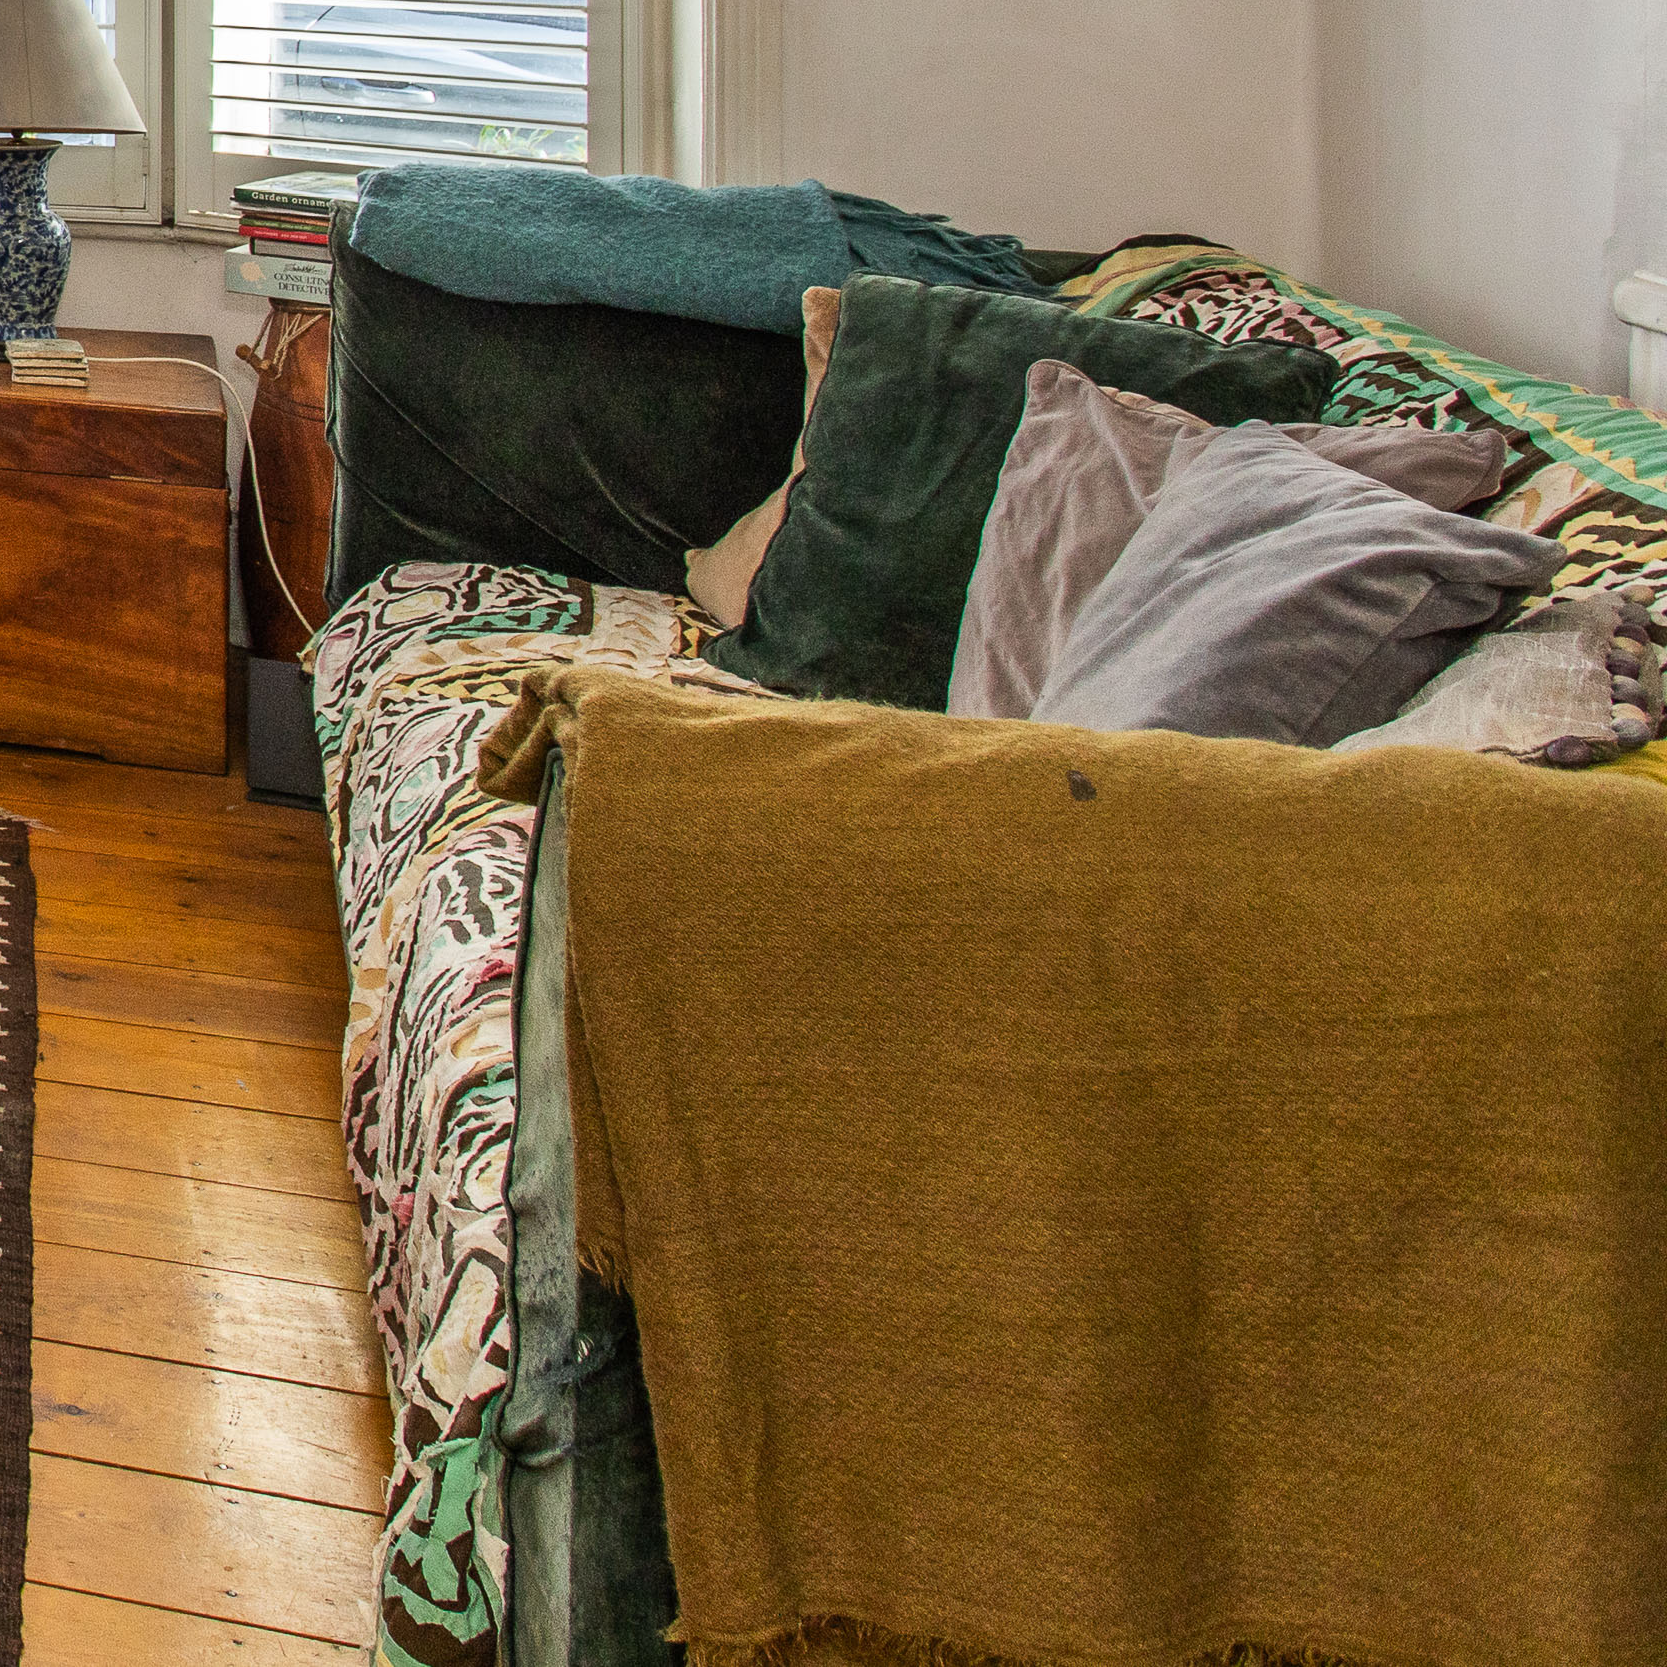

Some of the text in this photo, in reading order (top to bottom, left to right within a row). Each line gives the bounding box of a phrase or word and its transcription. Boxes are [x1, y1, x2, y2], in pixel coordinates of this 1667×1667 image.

[251, 191, 329, 207] Garden orname
[273, 273, 330, 286] CONSULTIN
[278, 281, 329, 296] DETECTIVE
